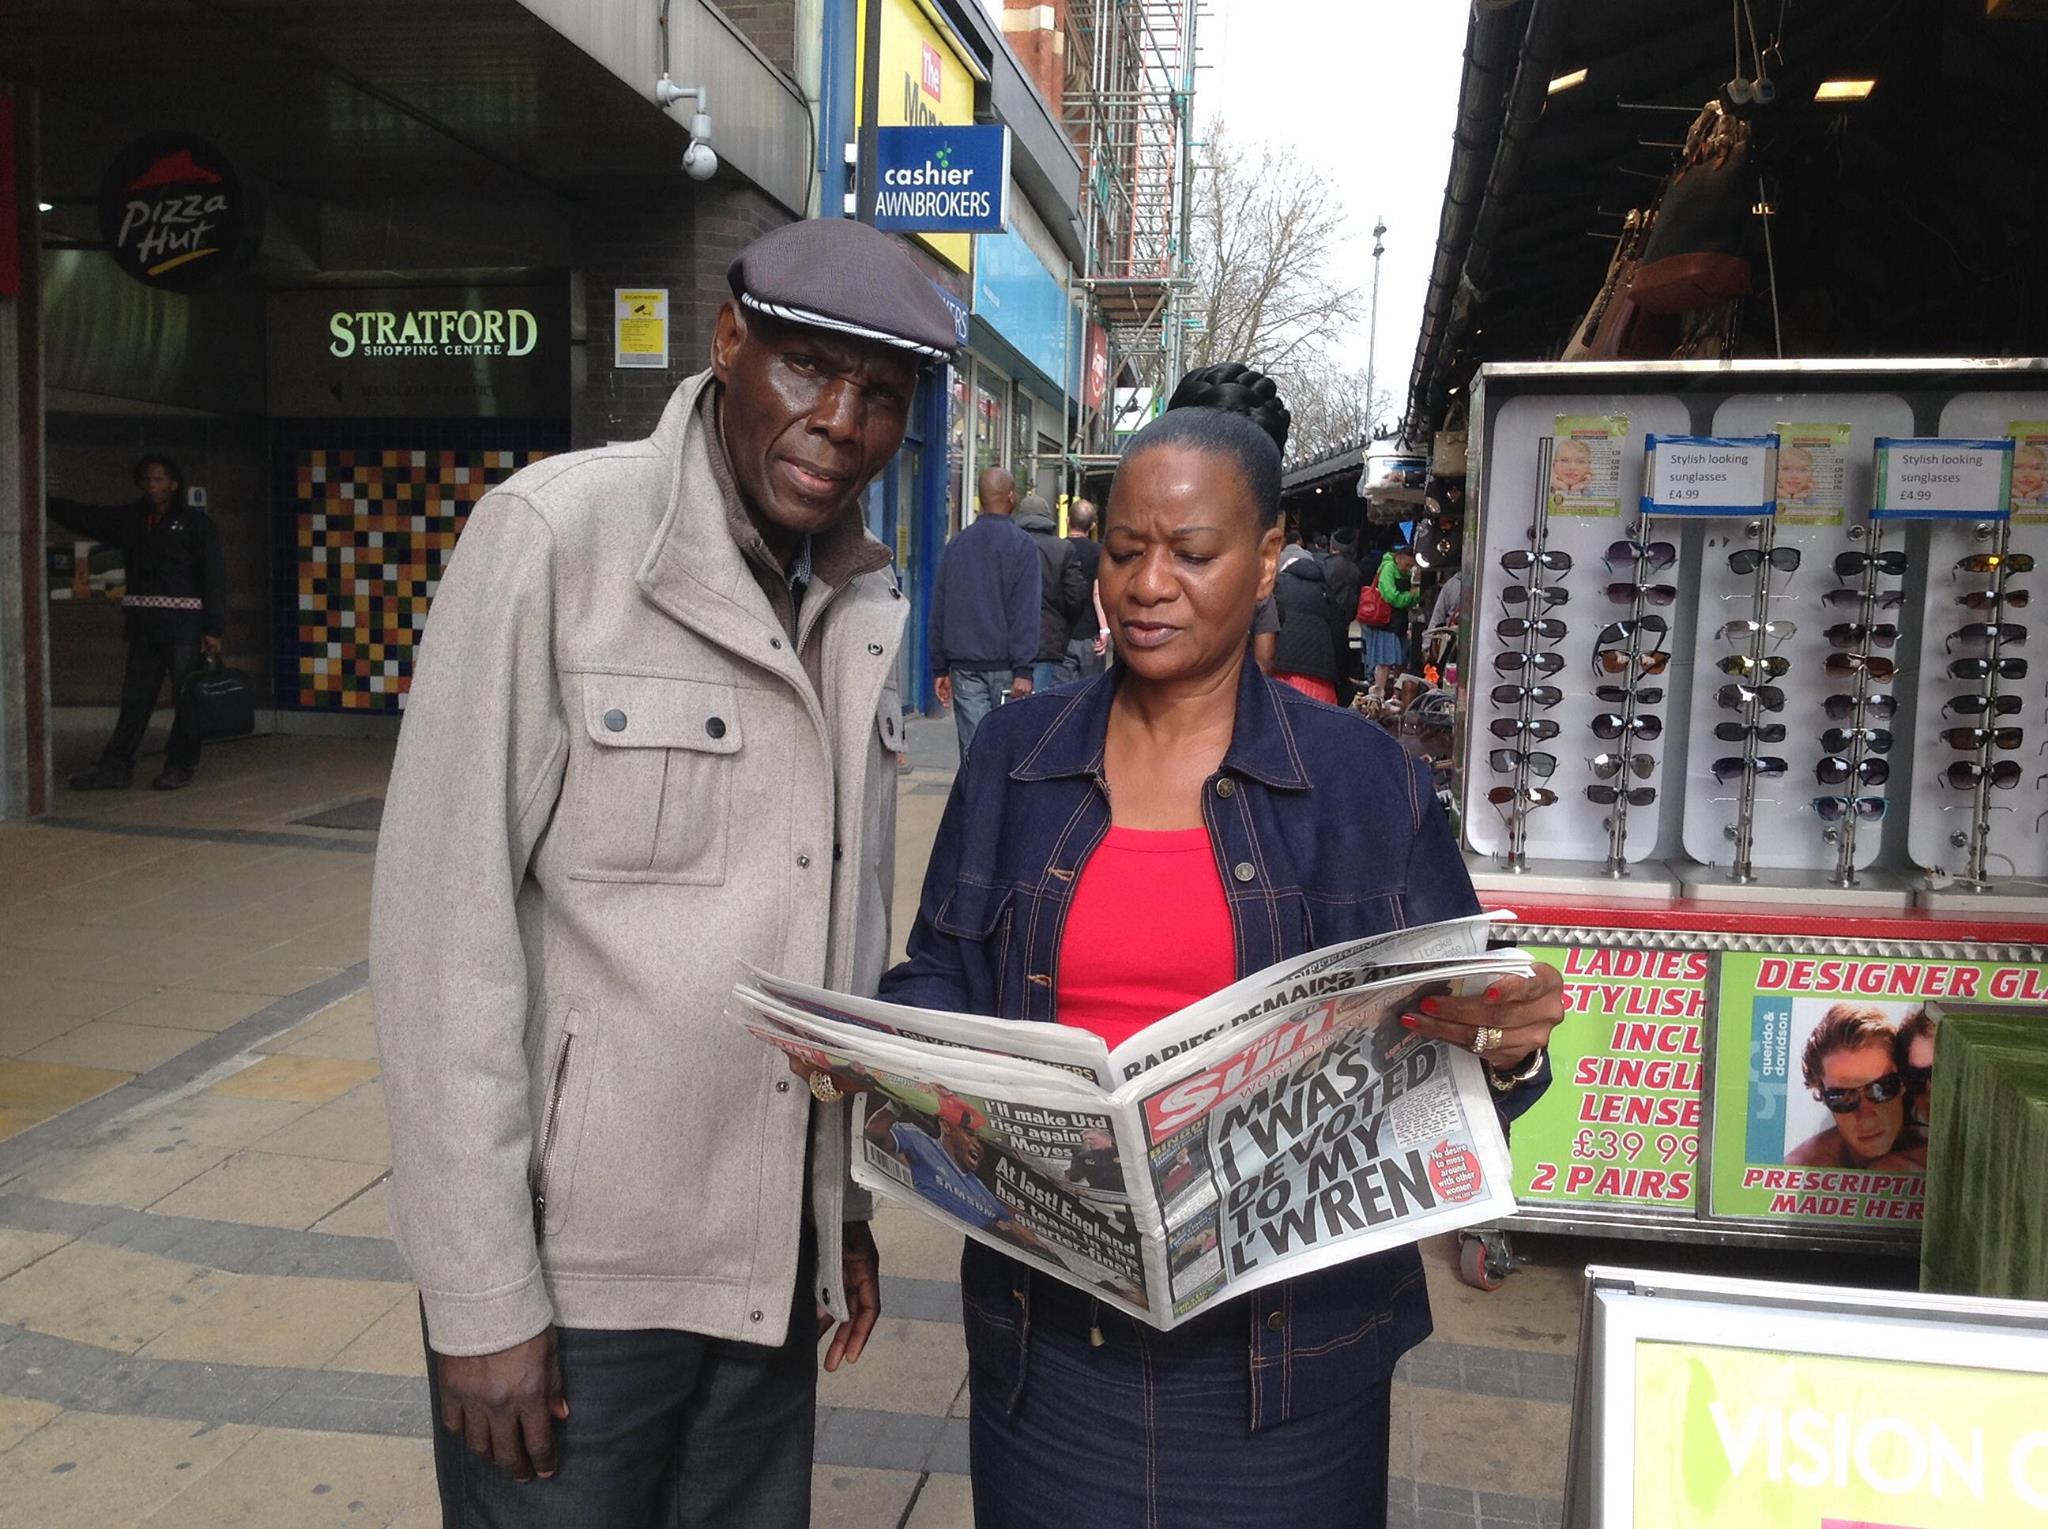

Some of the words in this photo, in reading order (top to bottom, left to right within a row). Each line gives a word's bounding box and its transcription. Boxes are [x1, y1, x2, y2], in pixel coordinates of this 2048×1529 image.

[923, 50, 940, 93] The
[885, 161, 974, 185] cashier
[118, 195, 228, 248] Pizza
[136, 220, 216, 262] Hut
[329, 309, 538, 358] STRATFORD
[364, 345, 438, 356] SHOPPING
[444, 345, 502, 356] CENTRE
[1671, 454, 1706, 466] Stylish
[1708, 454, 1748, 466] looking
[1902, 454, 1939, 466] Stylish
[1941, 454, 1984, 467] looking
[1670, 471, 1727, 482] sunglasses
[1901, 471, 1961, 484] sunglasses
[1669, 490, 1700, 500] £4.99
[1900, 490, 1932, 500] £4.99
[1563, 947, 1709, 981] LADIES
[1756, 959, 1980, 997] DESIGNER
[1989, 968, 2048, 1000] GL
[1610, 1022, 1704, 1055] INCL
[1775, 1012, 1788, 1077] davidson
[1154, 1008, 1329, 1131] Sun
[984, 1100, 1010, 1118] I'll
[1014, 1109, 1067, 1127] make
[1070, 1114, 1108, 1128] Utd
[990, 1118, 1023, 1135] rise
[1220, 1141, 1242, 1187] I
[1247, 1047, 1369, 1159] WAS
[1580, 1094, 1702, 1128] LENSE
[1228, 1044, 1437, 1214] DEVOTED
[1009, 1135, 1073, 1157] Moyes
[1436, 1160, 1445, 1168] to
[1446, 1155, 1465, 1165] mess
[1444, 1144, 1467, 1157] desire
[1573, 1130, 1643, 1162] £39
[1229, 1179, 1292, 1238] TO
[1308, 1109, 1386, 1195] MY
[1438, 1176, 1454, 1187] with
[1455, 1172, 1475, 1182] other
[1440, 1162, 1467, 1177] around
[1531, 1164, 1556, 1192] 2
[1566, 1166, 1690, 1200] PAIRS
[1743, 1169, 1926, 1197] PRESCRIPTI
[995, 1156, 1017, 1184] At
[1019, 1168, 1058, 1212] last!
[1061, 1200, 1136, 1256] England
[1230, 1149, 1437, 1277] L'WREN
[1770, 1194, 1858, 1217] MADE
[996, 1178, 1026, 1211] has
[1030, 1205, 1078, 1239] team
[1083, 1233, 1101, 1250] in
[1106, 1246, 1140, 1268] the
[1707, 1402, 1985, 1502] VISION
